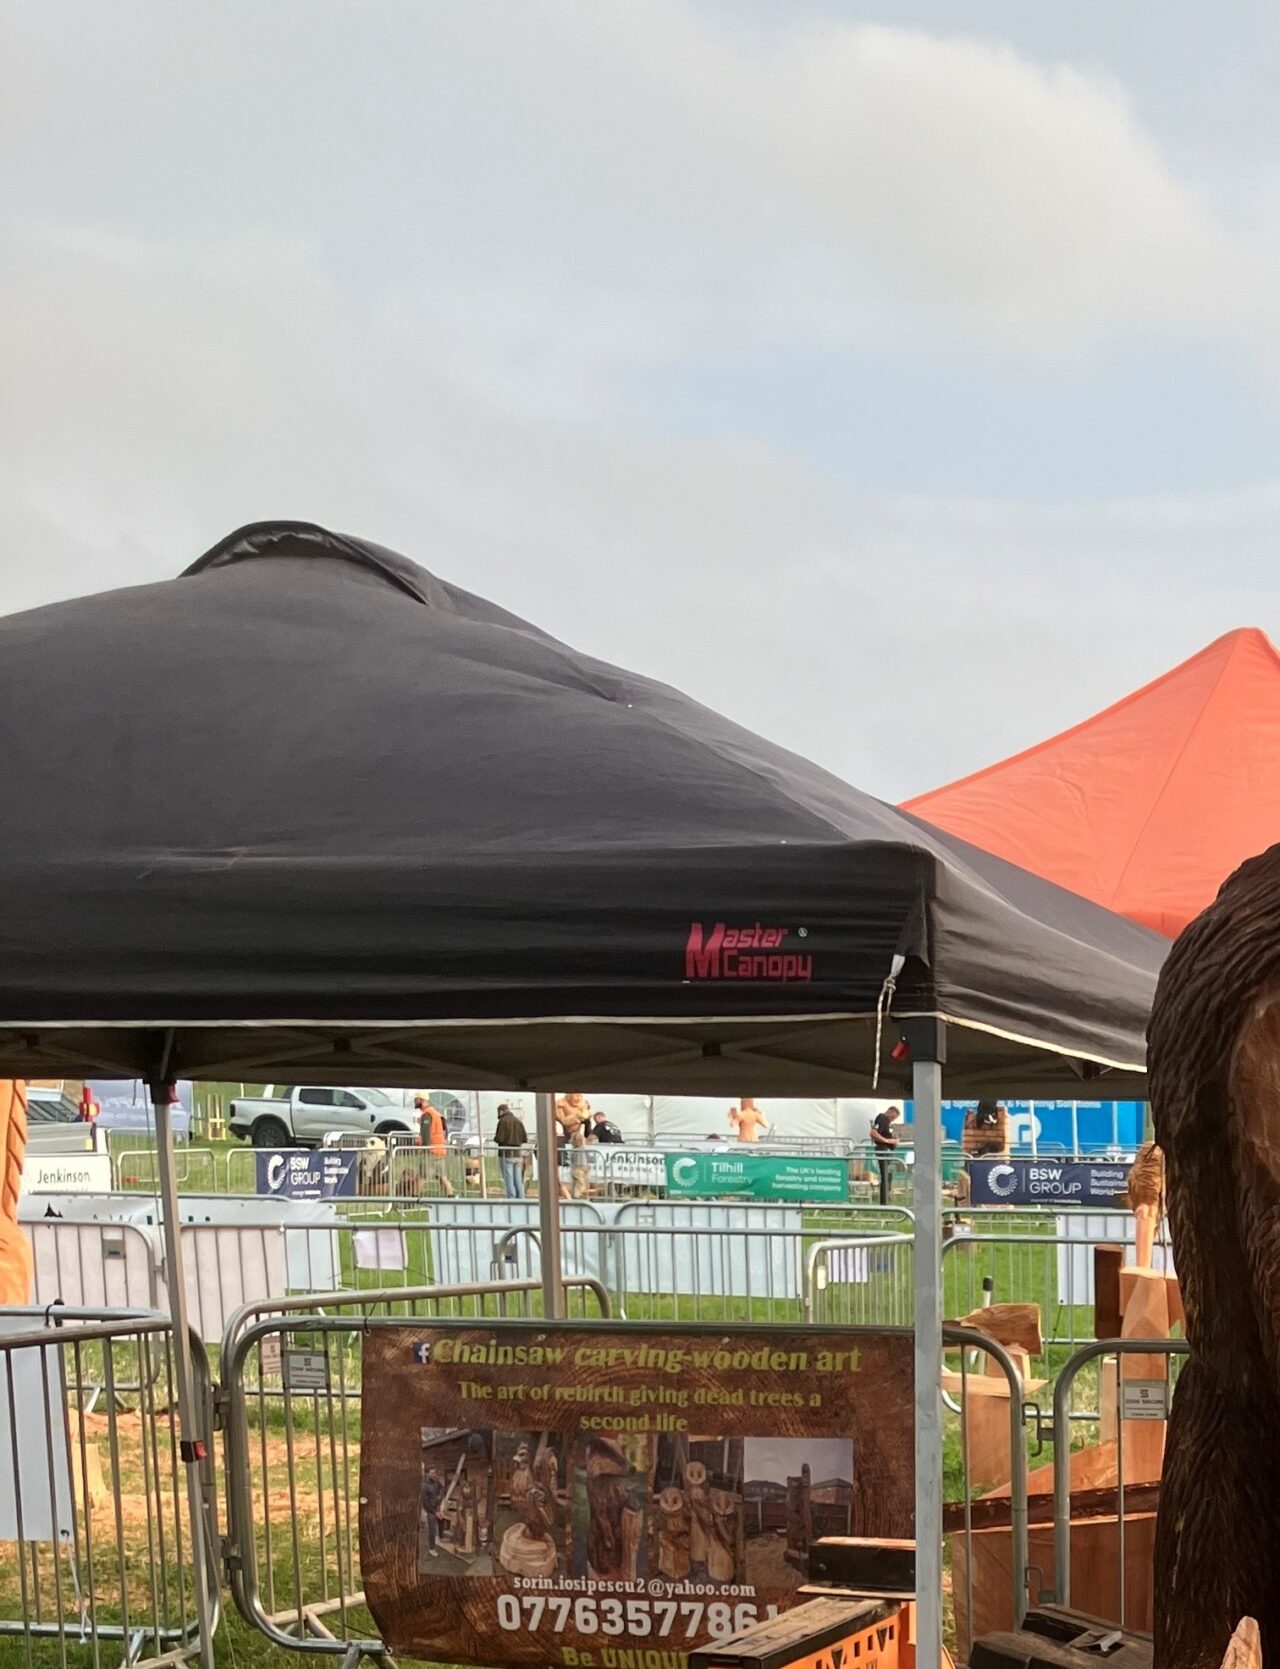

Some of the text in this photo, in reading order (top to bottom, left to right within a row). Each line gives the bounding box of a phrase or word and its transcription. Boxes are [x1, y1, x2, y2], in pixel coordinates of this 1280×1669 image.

[686, 922, 789, 978] Master
[723, 949, 812, 982] Canopy
[37, 1169, 91, 1184] Jenkinson
[711, 1162, 743, 1174] Tilhill
[1029, 1168, 1063, 1180] BSW
[1090, 1169, 1124, 1179] Building
[290, 1172, 321, 1185] GROUP
[1029, 1181, 1082, 1195] GROUP
[432, 1339, 565, 1366] Chainsaw
[574, 1343, 808, 1374] carving-wooden
[816, 1345, 862, 1372] art
[459, 1380, 822, 1408] The art of rebirth giving dead trees a
[579, 1412, 689, 1432] second life
[513, 1574, 757, 1599] sorin.iosipescu2@yahoo.com
[561, 1647, 596, 1668] Be
